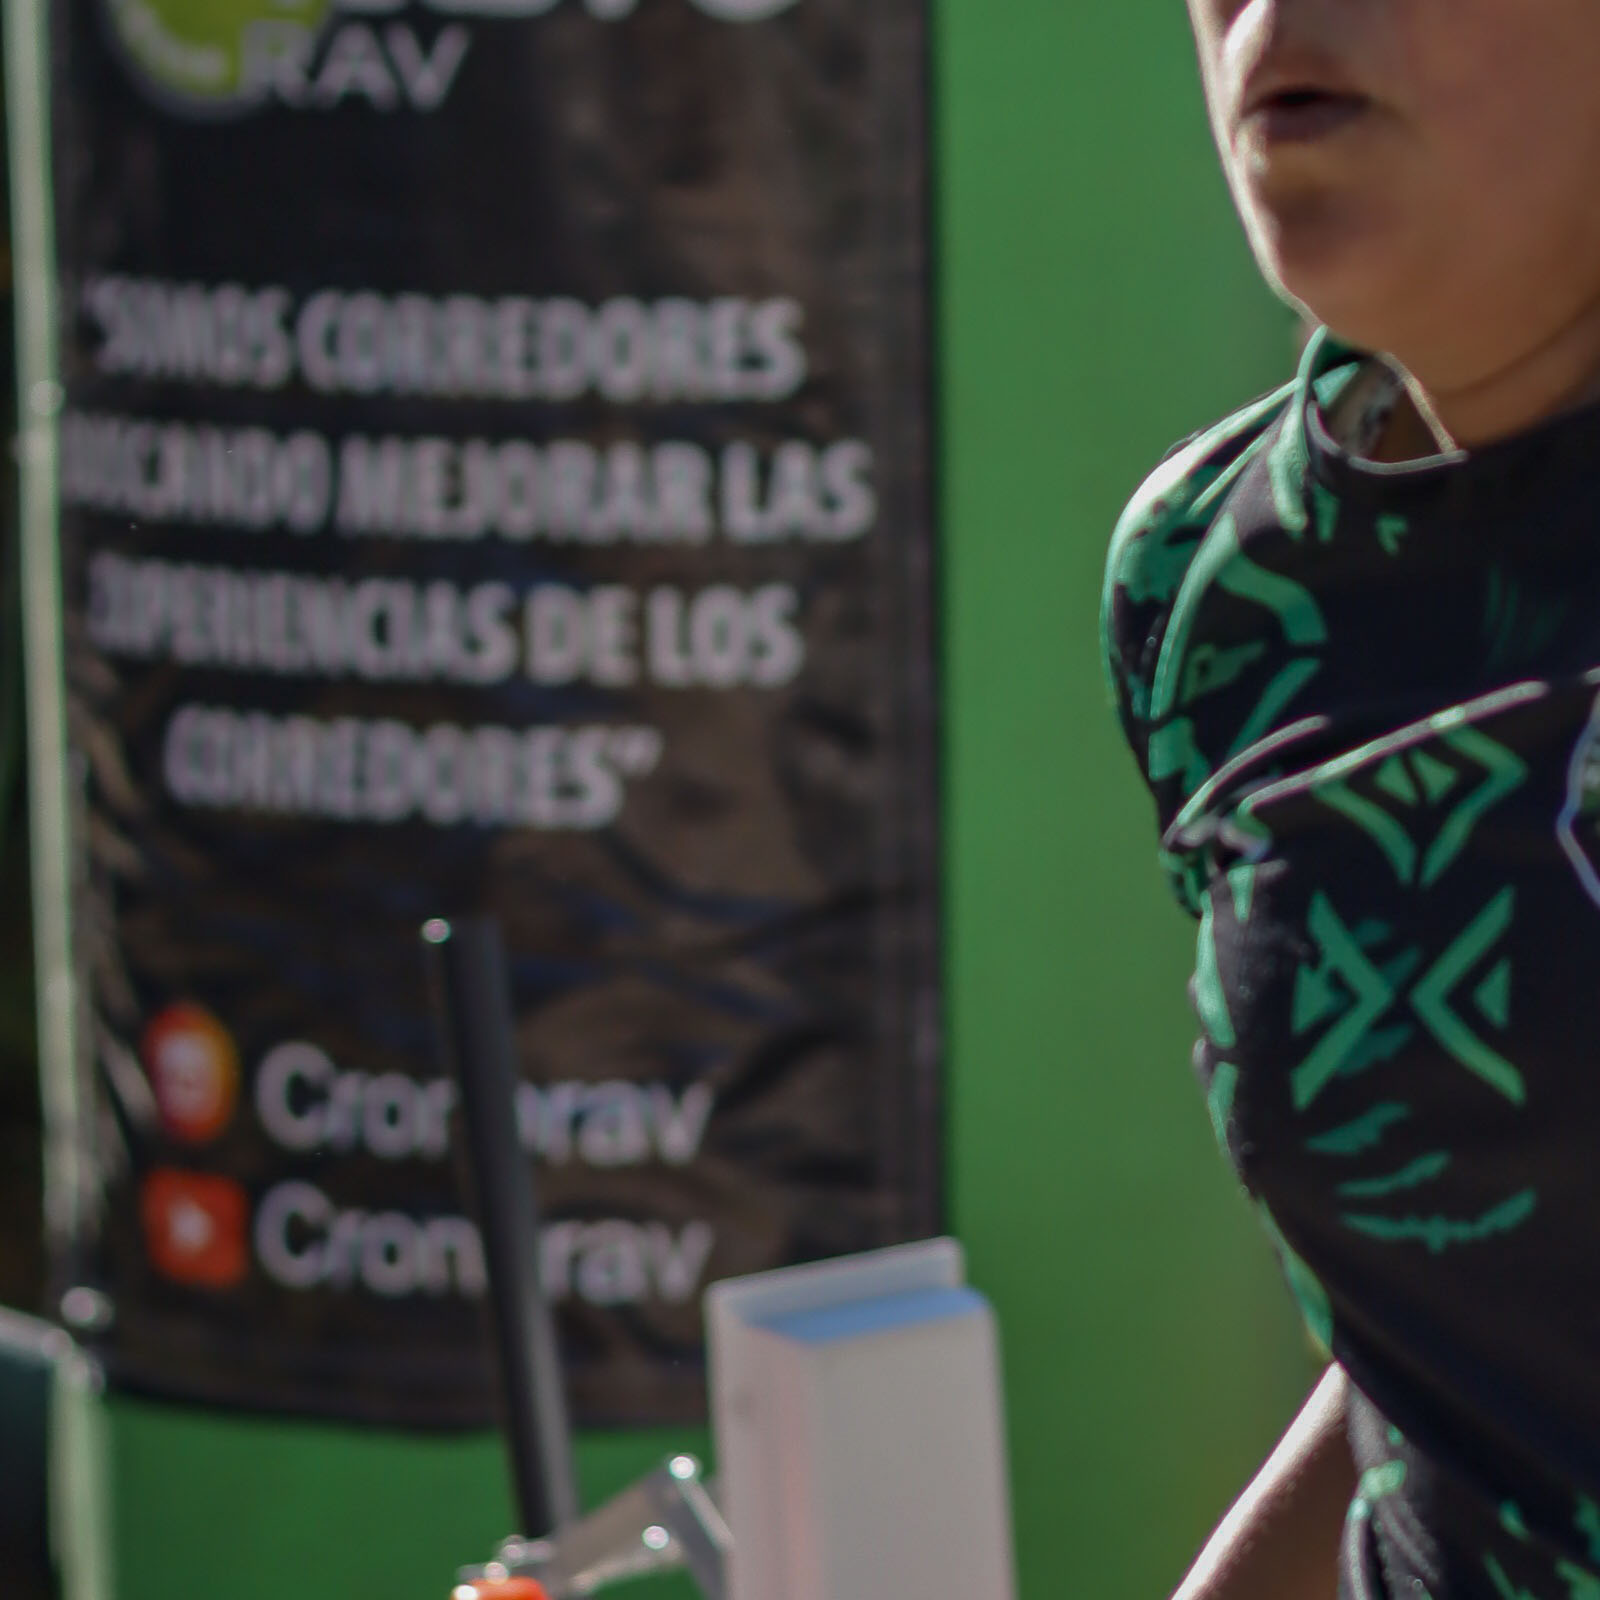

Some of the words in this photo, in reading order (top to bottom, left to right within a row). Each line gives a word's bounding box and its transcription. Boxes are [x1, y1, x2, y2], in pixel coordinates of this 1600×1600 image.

[240, 22, 470, 109] RAV
[296, 288, 806, 402] CORREDORES
[337, 432, 714, 542] MEJORAR
[724, 440, 877, 539] LAS
[526, 584, 638, 690] DE
[648, 586, 805, 690] LOS
[256, 1179, 716, 1306] Cronrav
